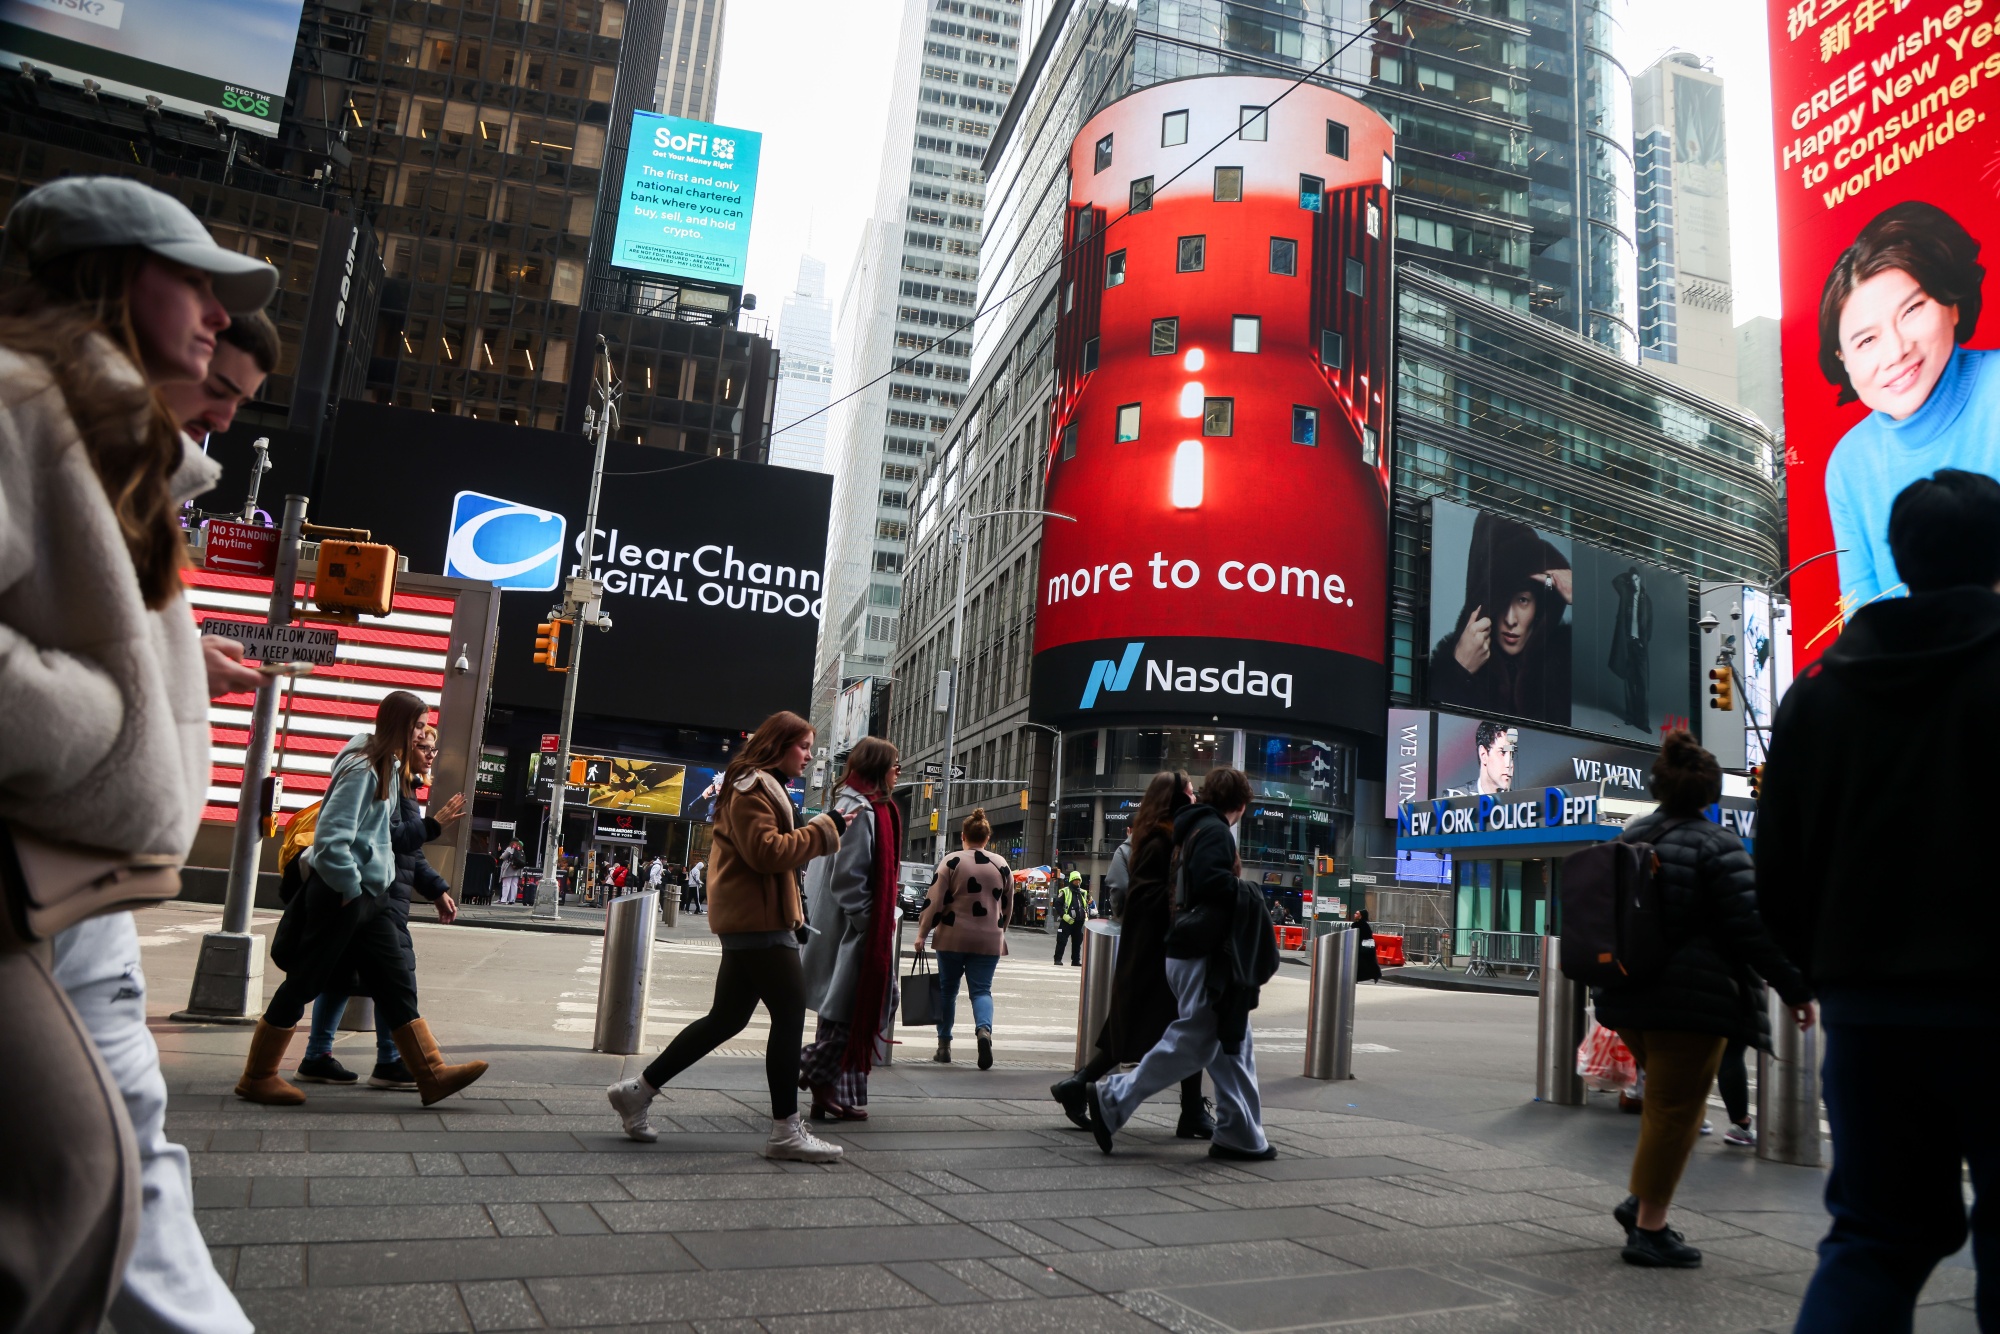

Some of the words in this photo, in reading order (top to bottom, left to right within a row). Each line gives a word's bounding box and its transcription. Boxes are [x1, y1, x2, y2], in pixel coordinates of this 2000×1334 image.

[1791, 61, 1867, 130] GREE
[1871, 0, 1983, 77] wishes
[222, 91, 270, 117] SOS
[225, 85, 254, 96] DETECT
[256, 92, 271, 102] THE
[1782, 101, 1866, 171] Happy
[1872, 53, 1940, 114] New
[1946, 12, 2000, 61] Ye
[1801, 161, 1829, 189] to
[1833, 51, 2000, 170] consumers
[654, 128, 708, 155] SoFi
[652, 149, 667, 158] Get
[668, 152, 685, 161] Your
[686, 155, 712, 168] Money
[713, 160, 733, 170] Right
[1823, 107, 1986, 210] worldwide.
[636, 179, 684, 195] national
[686, 187, 741, 204] chartered
[643, 165, 665, 178] The
[666, 169, 689, 182] first
[691, 175, 713, 187] and
[715, 180, 740, 192] only
[630, 191, 659, 205] bank
[661, 197, 697, 211] where
[699, 203, 721, 216] you
[723, 208, 744, 219] can
[634, 205, 658, 219] buy,
[660, 209, 683, 223] sell,
[685, 214, 708, 226] and
[710, 217, 736, 231] hold
[663, 225, 704, 239] crypto.
[635, 244, 672, 254] INVESTMENTS
[685, 252, 705, 260] DIGITAL
[638, 254, 673, 265] GUARANTEED
[703, 264, 720, 272] VALUE
[666, 253, 689, 262] INSURED
[212, 524, 226, 536] NO
[229, 526, 276, 543] STANDING
[212, 536, 253, 550] Anytime
[574, 528, 821, 592] ClearChann
[1047, 561, 1133, 606] more
[1148, 551, 1200, 589] to
[1217, 560, 1354, 608] come.
[204, 620, 273, 641] PEDESTRIAN
[276, 628, 305, 643] FLOW
[308, 631, 336, 646] ZONE
[262, 644, 290, 660] KEEP
[292, 647, 334, 664] MOVING
[1146, 659, 1293, 708] Nasdaq
[1400, 724, 1418, 757] WE
[1572, 757, 1602, 782] WE
[1605, 762, 1645, 790] WIN.
[1264, 810, 1284, 819] Nasdaq
[1397, 803, 1430, 837] NEW
[1433, 799, 1475, 835] YORK
[1479, 794, 1537, 831] POLICE
[1545, 786, 1597, 826] DEPT
